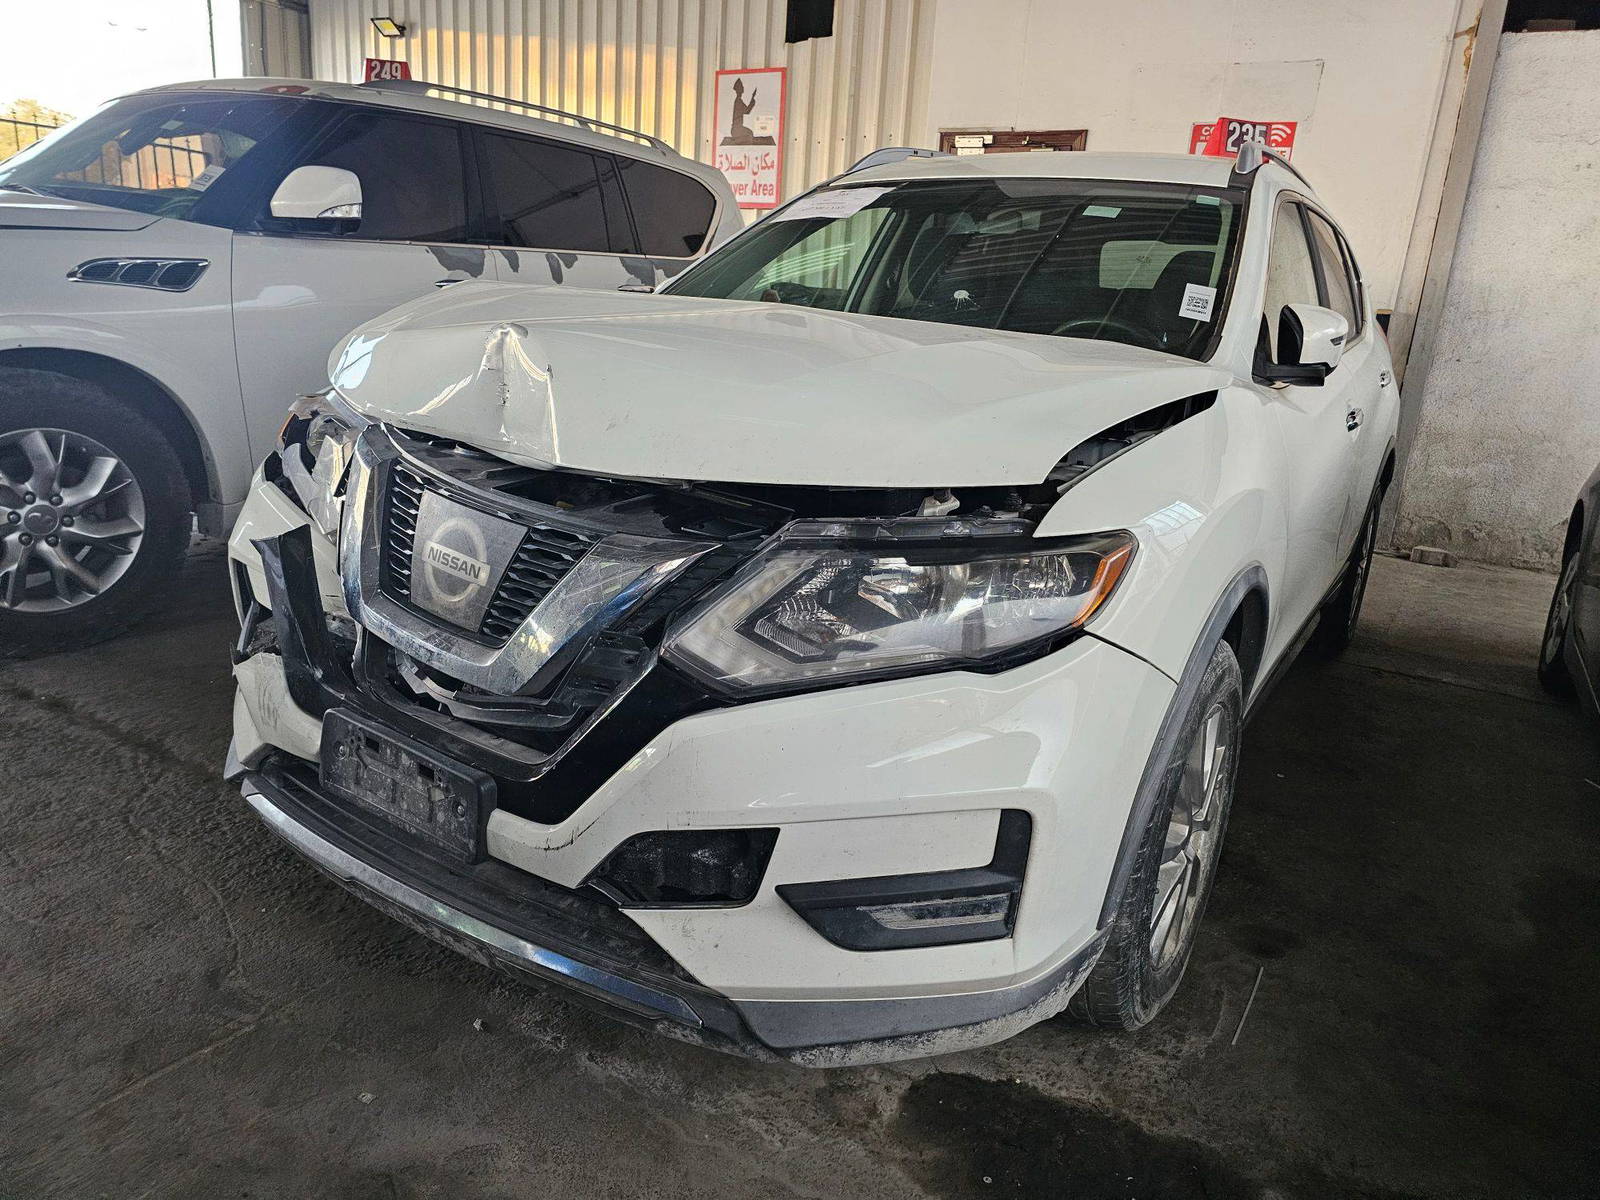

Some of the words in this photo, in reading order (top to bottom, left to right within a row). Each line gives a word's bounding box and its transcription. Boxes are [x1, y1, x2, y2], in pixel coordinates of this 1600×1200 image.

[370, 61, 402, 80] 249
[1226, 121, 1267, 153] 235
[718, 153, 750, 171] الصلاة
[751, 152, 775, 176] مكان
[751, 179, 775, 196] Area
[427, 546, 482, 579] NISSAN
